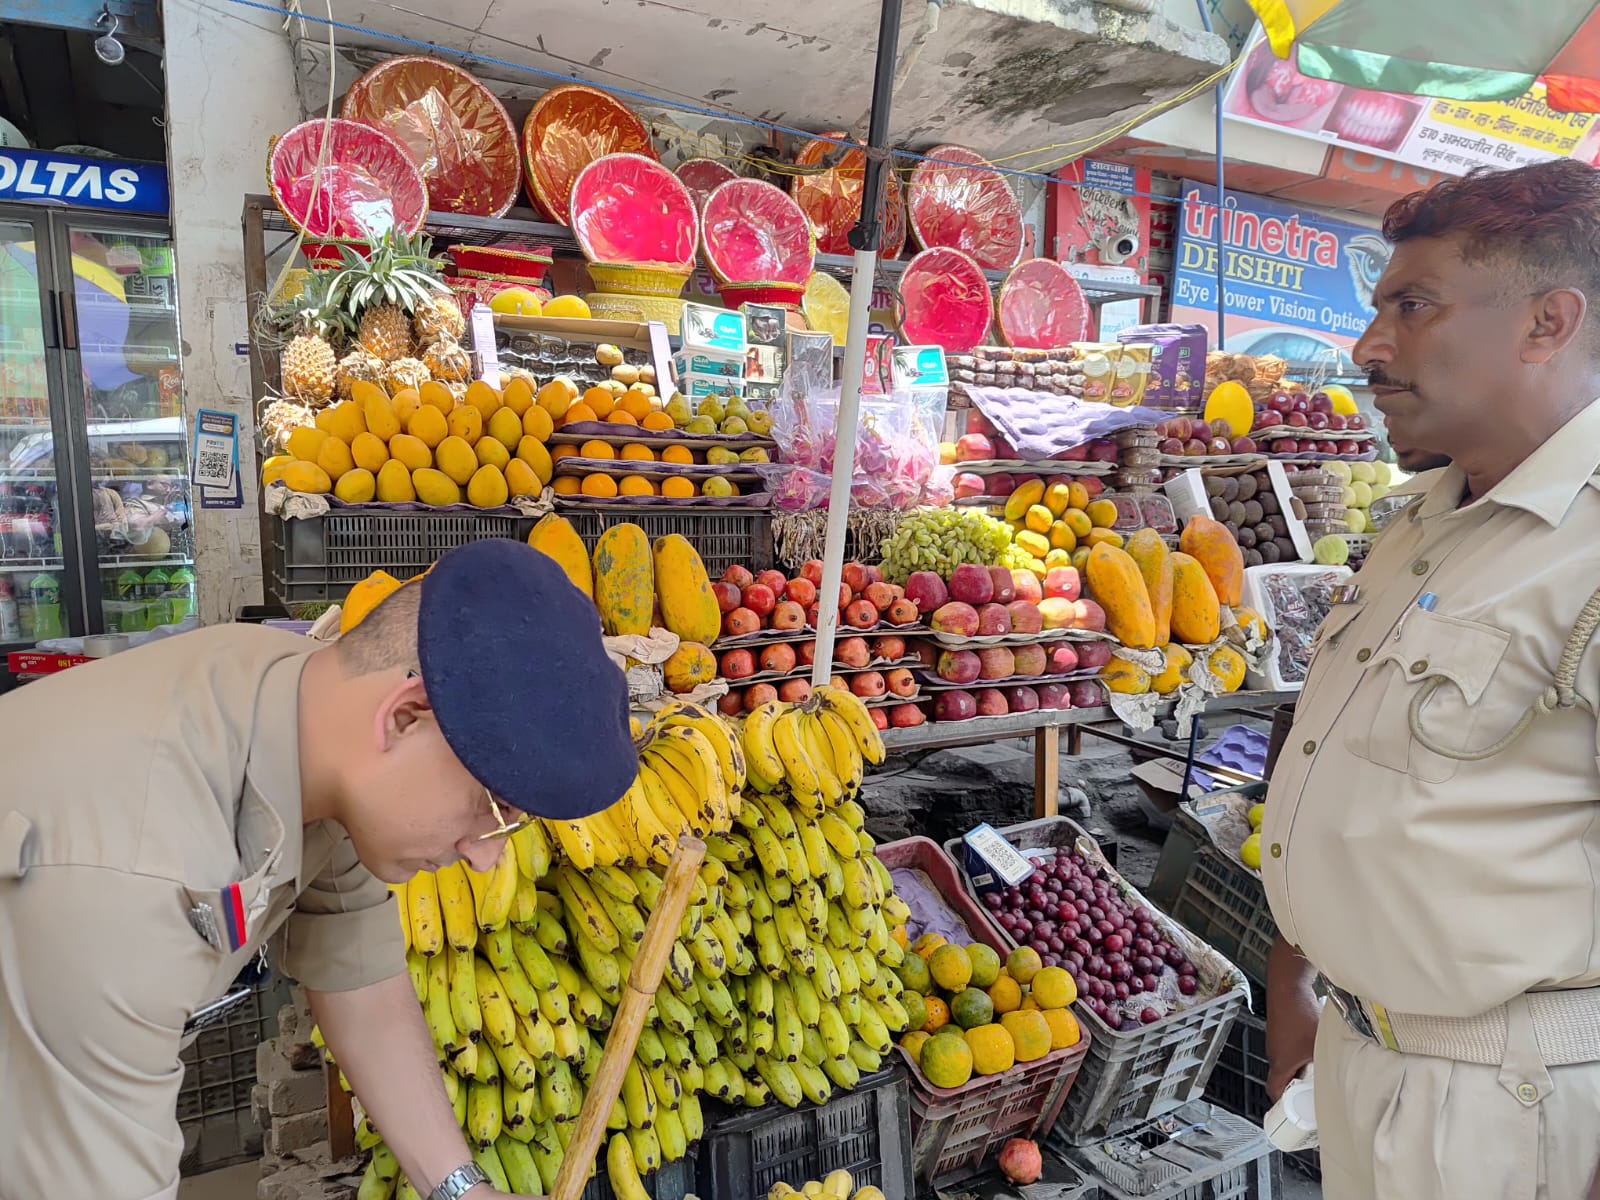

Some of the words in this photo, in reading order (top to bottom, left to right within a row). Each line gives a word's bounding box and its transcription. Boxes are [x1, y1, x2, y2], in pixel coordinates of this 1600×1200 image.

[1184, 188, 1338, 268] trinetra
[1180, 242, 1305, 290] DRISHTI
[1176, 278, 1210, 305] Eye
[1213, 285, 1265, 312] Power
[1269, 295, 1317, 323] Vision
[1321, 307, 1367, 332] Optics
